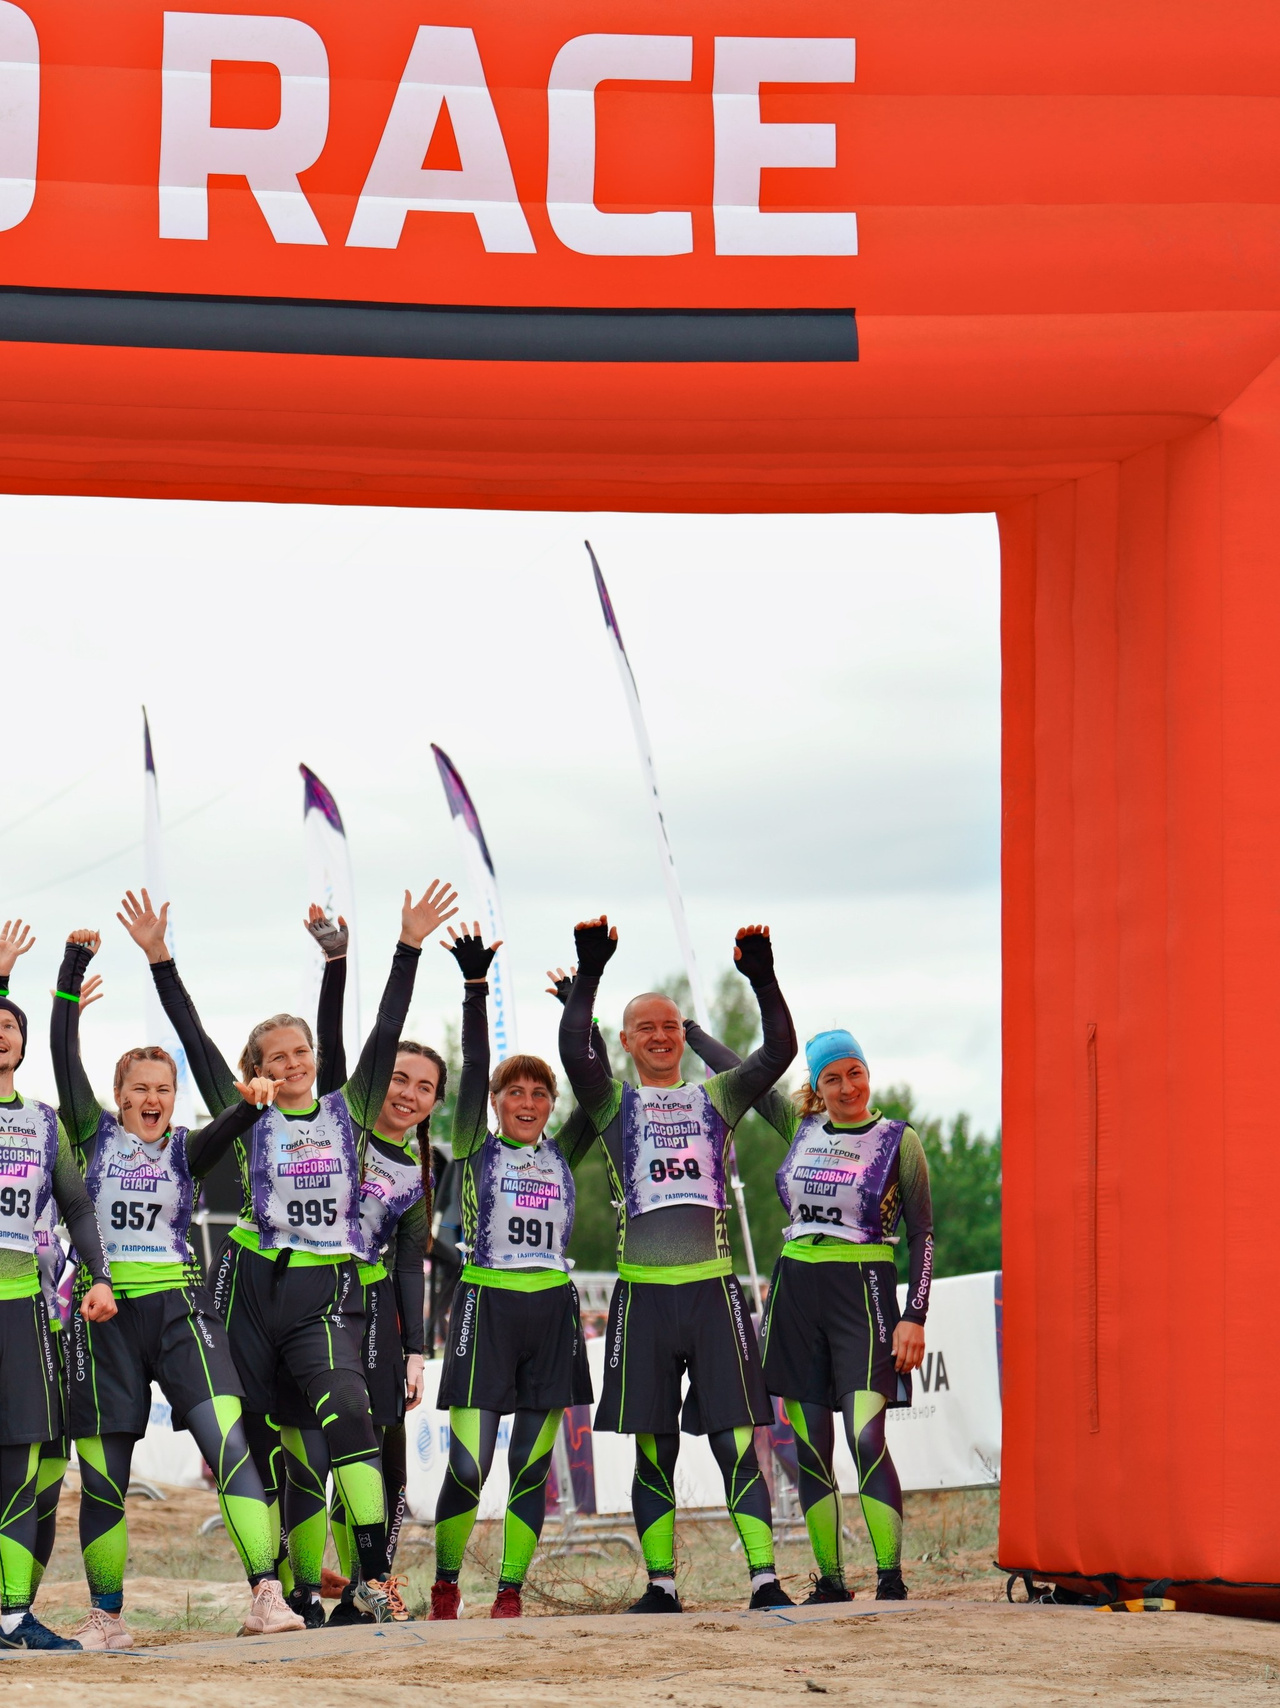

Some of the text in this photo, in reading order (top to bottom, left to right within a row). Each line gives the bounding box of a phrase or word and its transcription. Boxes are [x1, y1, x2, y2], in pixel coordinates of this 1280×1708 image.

[159, 11, 859, 257] RACE
[7, 1125, 37, 1135] ГЕРОЕВ
[647, 1120, 698, 1136] АССОВЫЙ
[281, 1139, 304, 1151] ГОНКА
[655, 1136, 686, 1148] СТАРТ
[829, 1148, 861, 1161] ГЕРОЕВ
[280, 1159, 340, 1175] МАССОВЫЙ
[370, 1163, 396, 1186] ГЕРОЕВ
[795, 1167, 853, 1184] МАССОВЫЙ
[122, 1178, 155, 1191] СТАРТ
[296, 1175, 328, 1188] СТАРТ
[503, 1179, 559, 1198] МАССОВЫЙ
[805, 1181, 835, 1196] СТАРТ
[517, 1194, 547, 1208] СТАРТ
[665, 1192, 708, 1201] ГАЗПРОМБАНК
[111, 1201, 163, 1232] 957
[287, 1198, 337, 1226] 995
[508, 1216, 554, 1250] 991
[121, 1244, 167, 1253] ГАЗПРОМБАНК
[214, 1259, 231, 1310] enway
[911, 1242, 934, 1310] Greenway
[456, 1296, 475, 1357] Greenway
[74, 1316, 86, 1381] Greenway
[919, 1351, 950, 1394] VA
[385, 1495, 407, 1565] reenway
